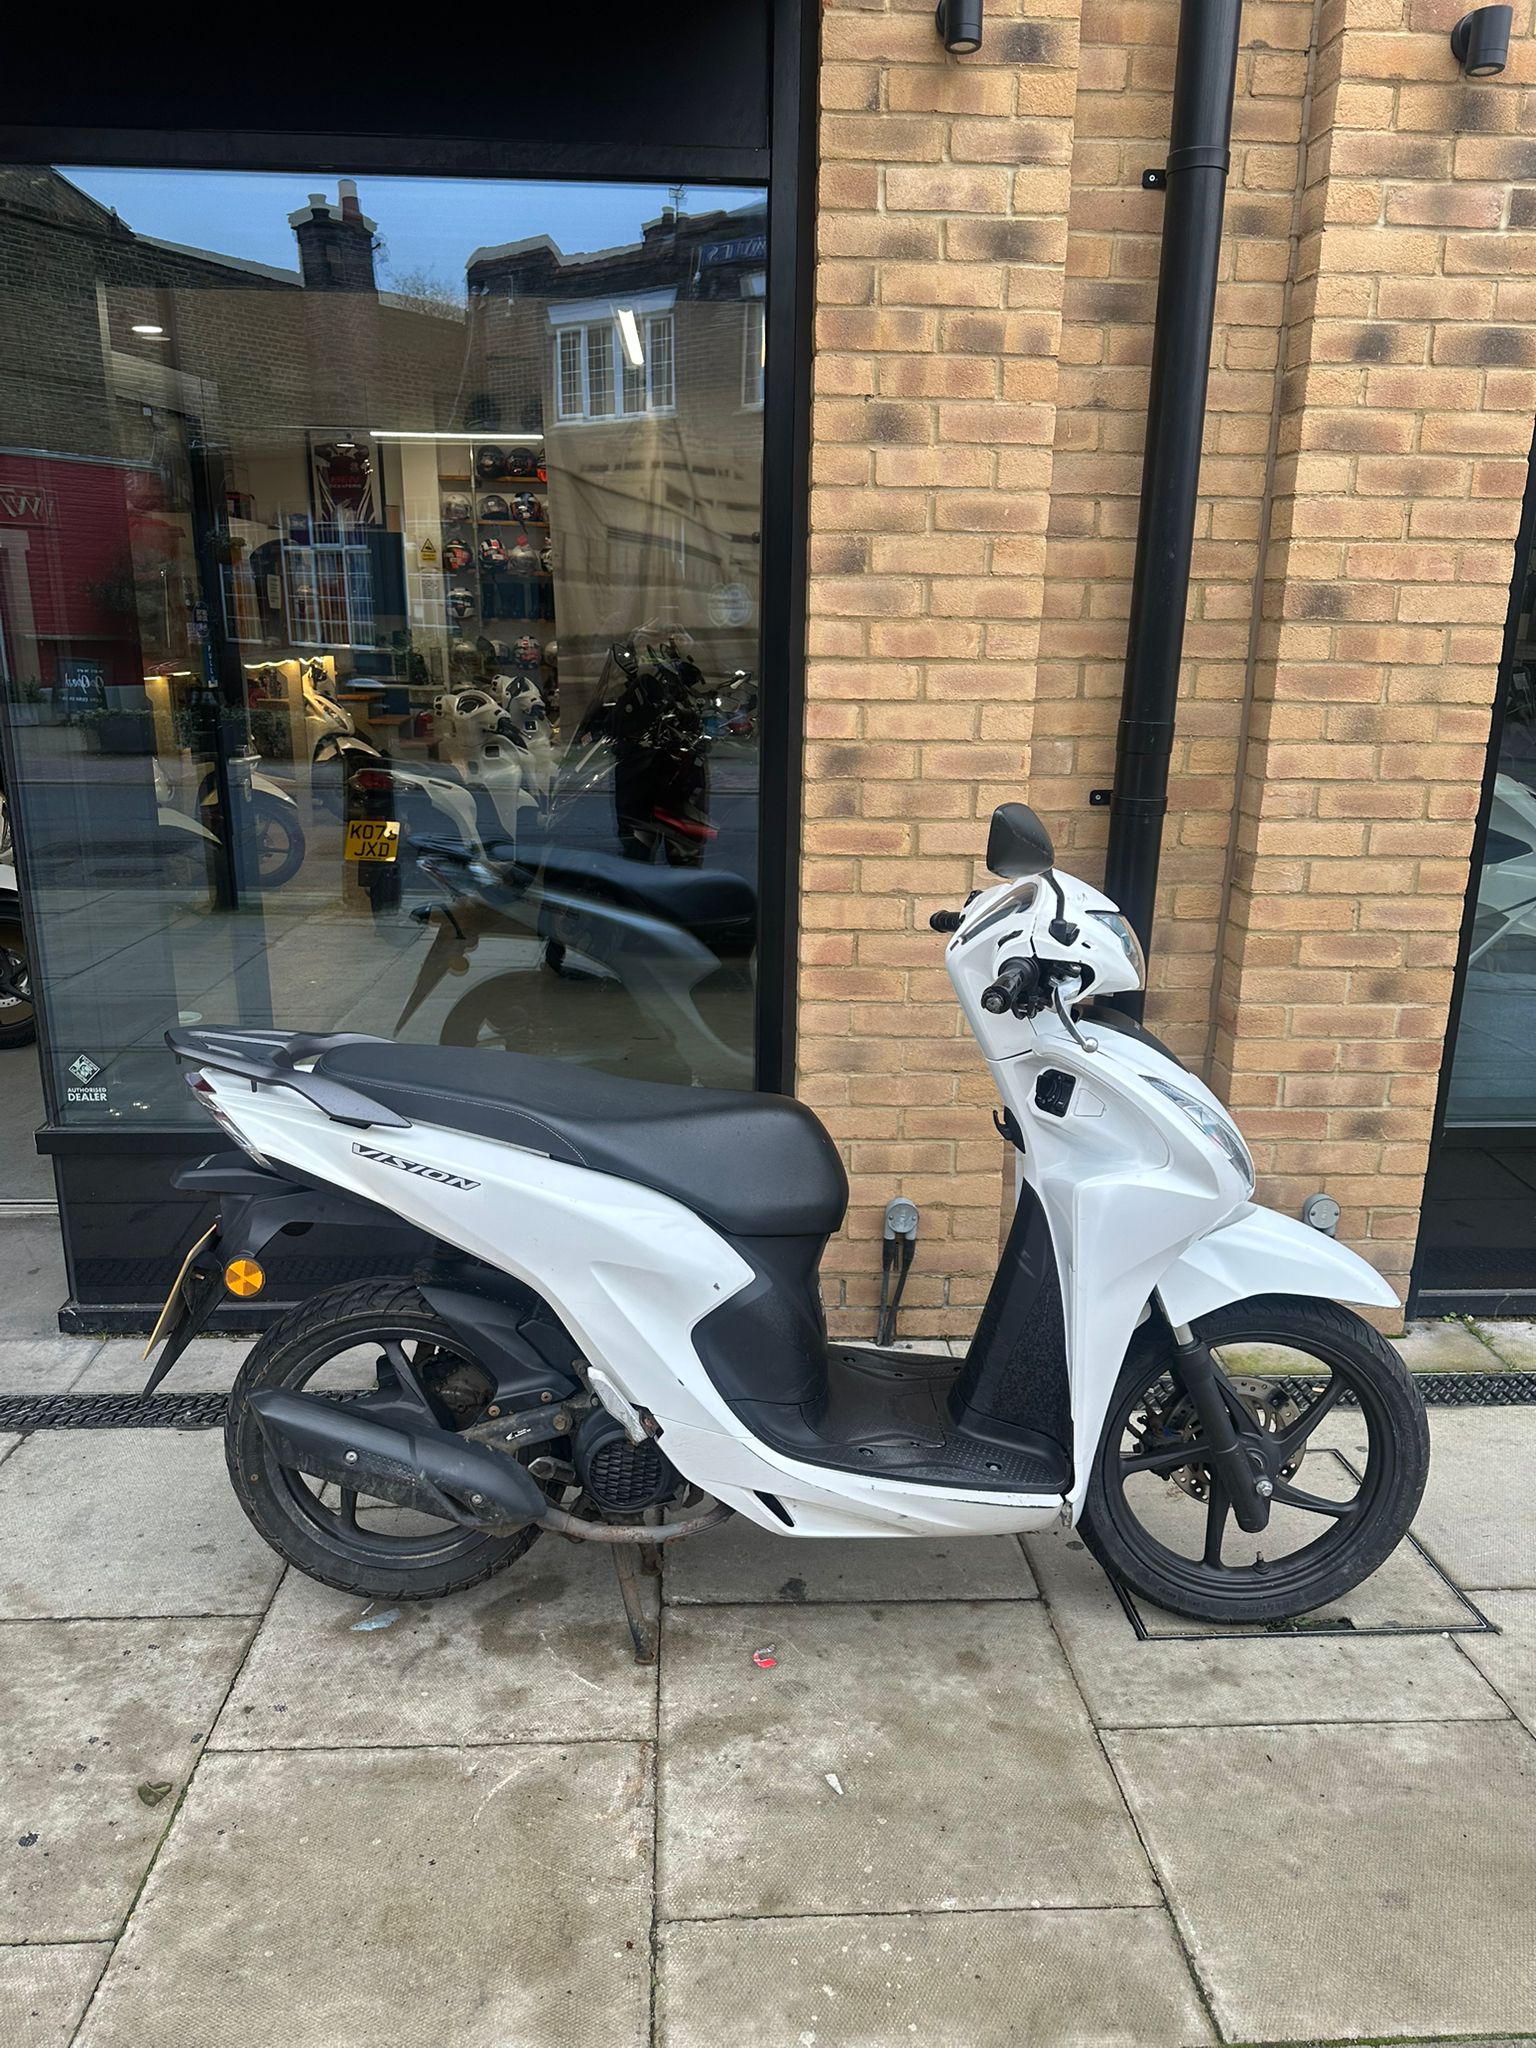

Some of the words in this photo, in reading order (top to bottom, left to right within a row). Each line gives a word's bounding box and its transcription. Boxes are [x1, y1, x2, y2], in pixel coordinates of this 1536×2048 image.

[354, 842, 389, 857] JXD
[67, 1093, 107, 1102] DEALER
[352, 1142, 480, 1190] VISION
